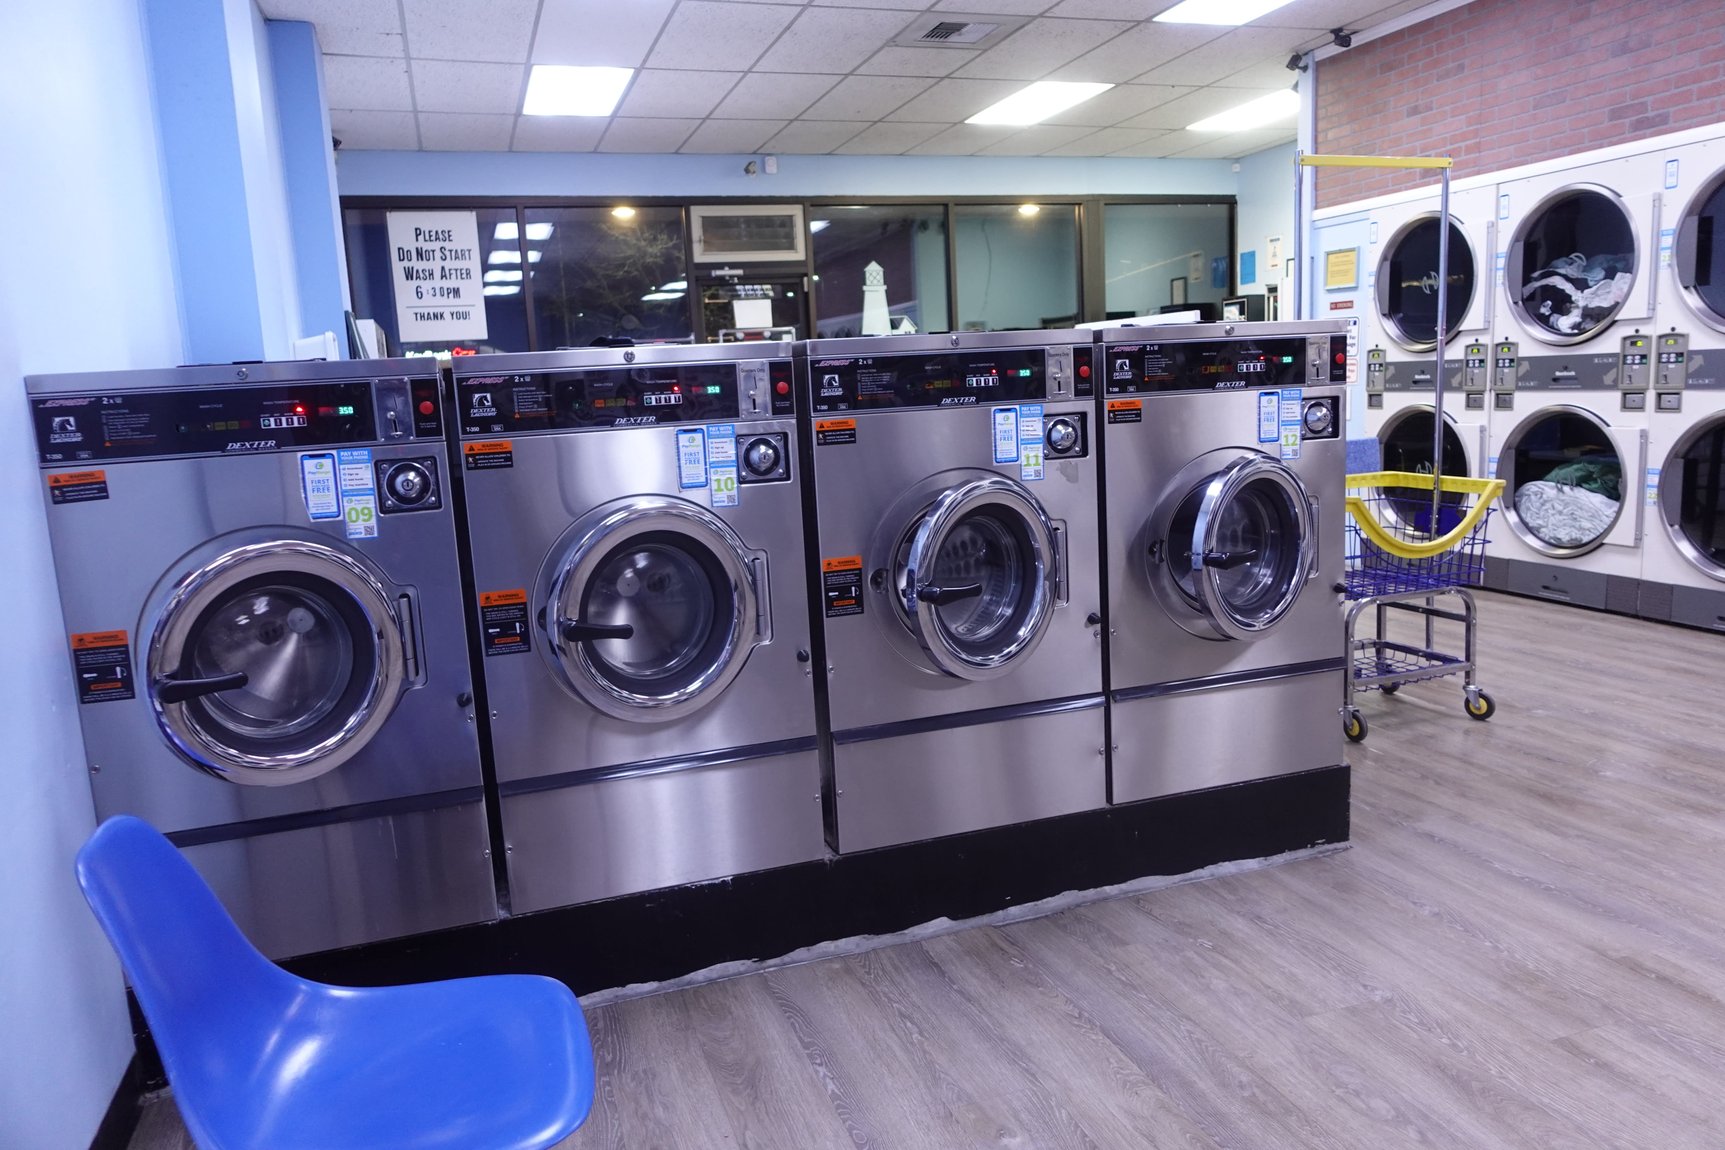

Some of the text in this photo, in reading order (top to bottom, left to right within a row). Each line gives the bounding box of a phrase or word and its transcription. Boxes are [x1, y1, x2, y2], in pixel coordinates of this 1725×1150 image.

[415, 227, 453, 242] PLEASE
[416, 247, 436, 262] NOT
[440, 246, 472, 261] START
[404, 266, 472, 281] WASH AFTER
[413, 311, 471, 322] THANK YOU!
[941, 396, 976, 404] DEXTER
[615, 416, 656, 424] DEXTER
[226, 440, 276, 450] DEXTER
[1283, 434, 1298, 446] 12
[1023, 453, 1041, 467] 11
[714, 477, 735, 492] 10
[347, 506, 373, 523] 09
